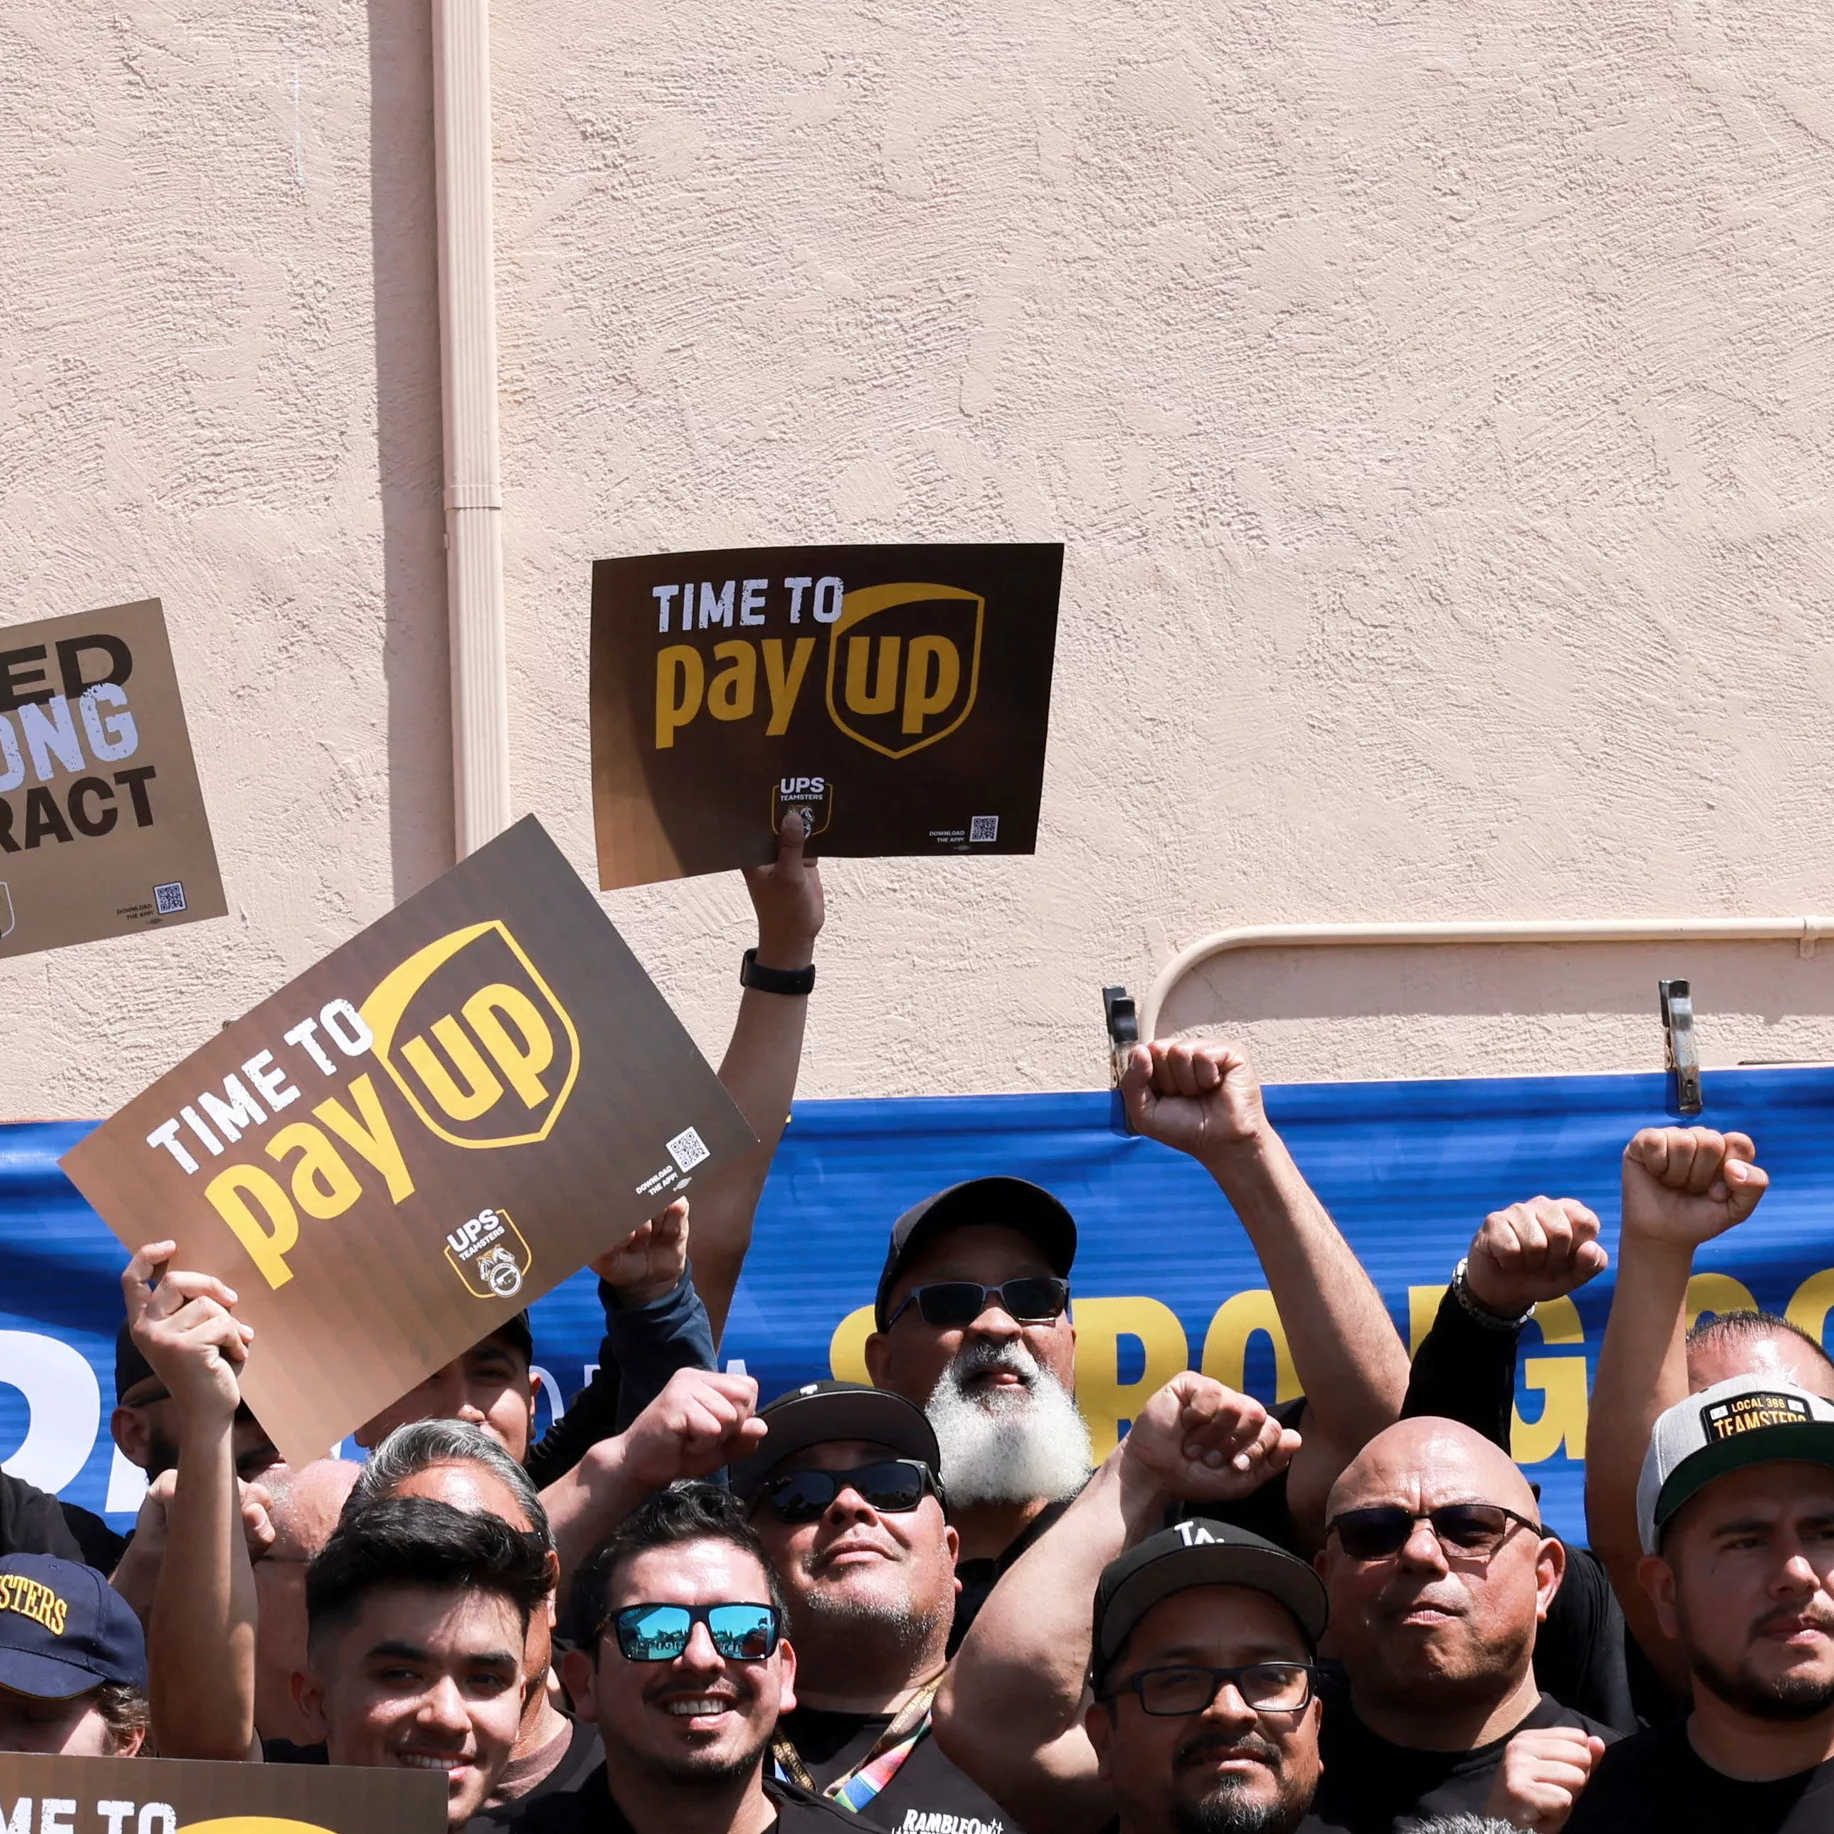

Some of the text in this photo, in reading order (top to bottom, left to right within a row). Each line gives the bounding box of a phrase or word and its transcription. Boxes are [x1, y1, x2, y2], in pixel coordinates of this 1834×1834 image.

[652, 576, 844, 633] TIME TO
[655, 635, 960, 749] pay up
[780, 777, 825, 793] UPS
[117, 903, 153, 916] DOWNLOAD
[145, 998, 374, 1175] TIME TO
[203, 983, 553, 1291] pay up
[635, 1165, 674, 1195] DOWNLOAD
[648, 1172, 678, 1197] THE APP!
[447, 1208, 500, 1253] UPS
[459, 1226, 506, 1262] TEAMSTERS
[1731, 1398, 1764, 1413] LOCAL
[1766, 1398, 1786, 1409] 396
